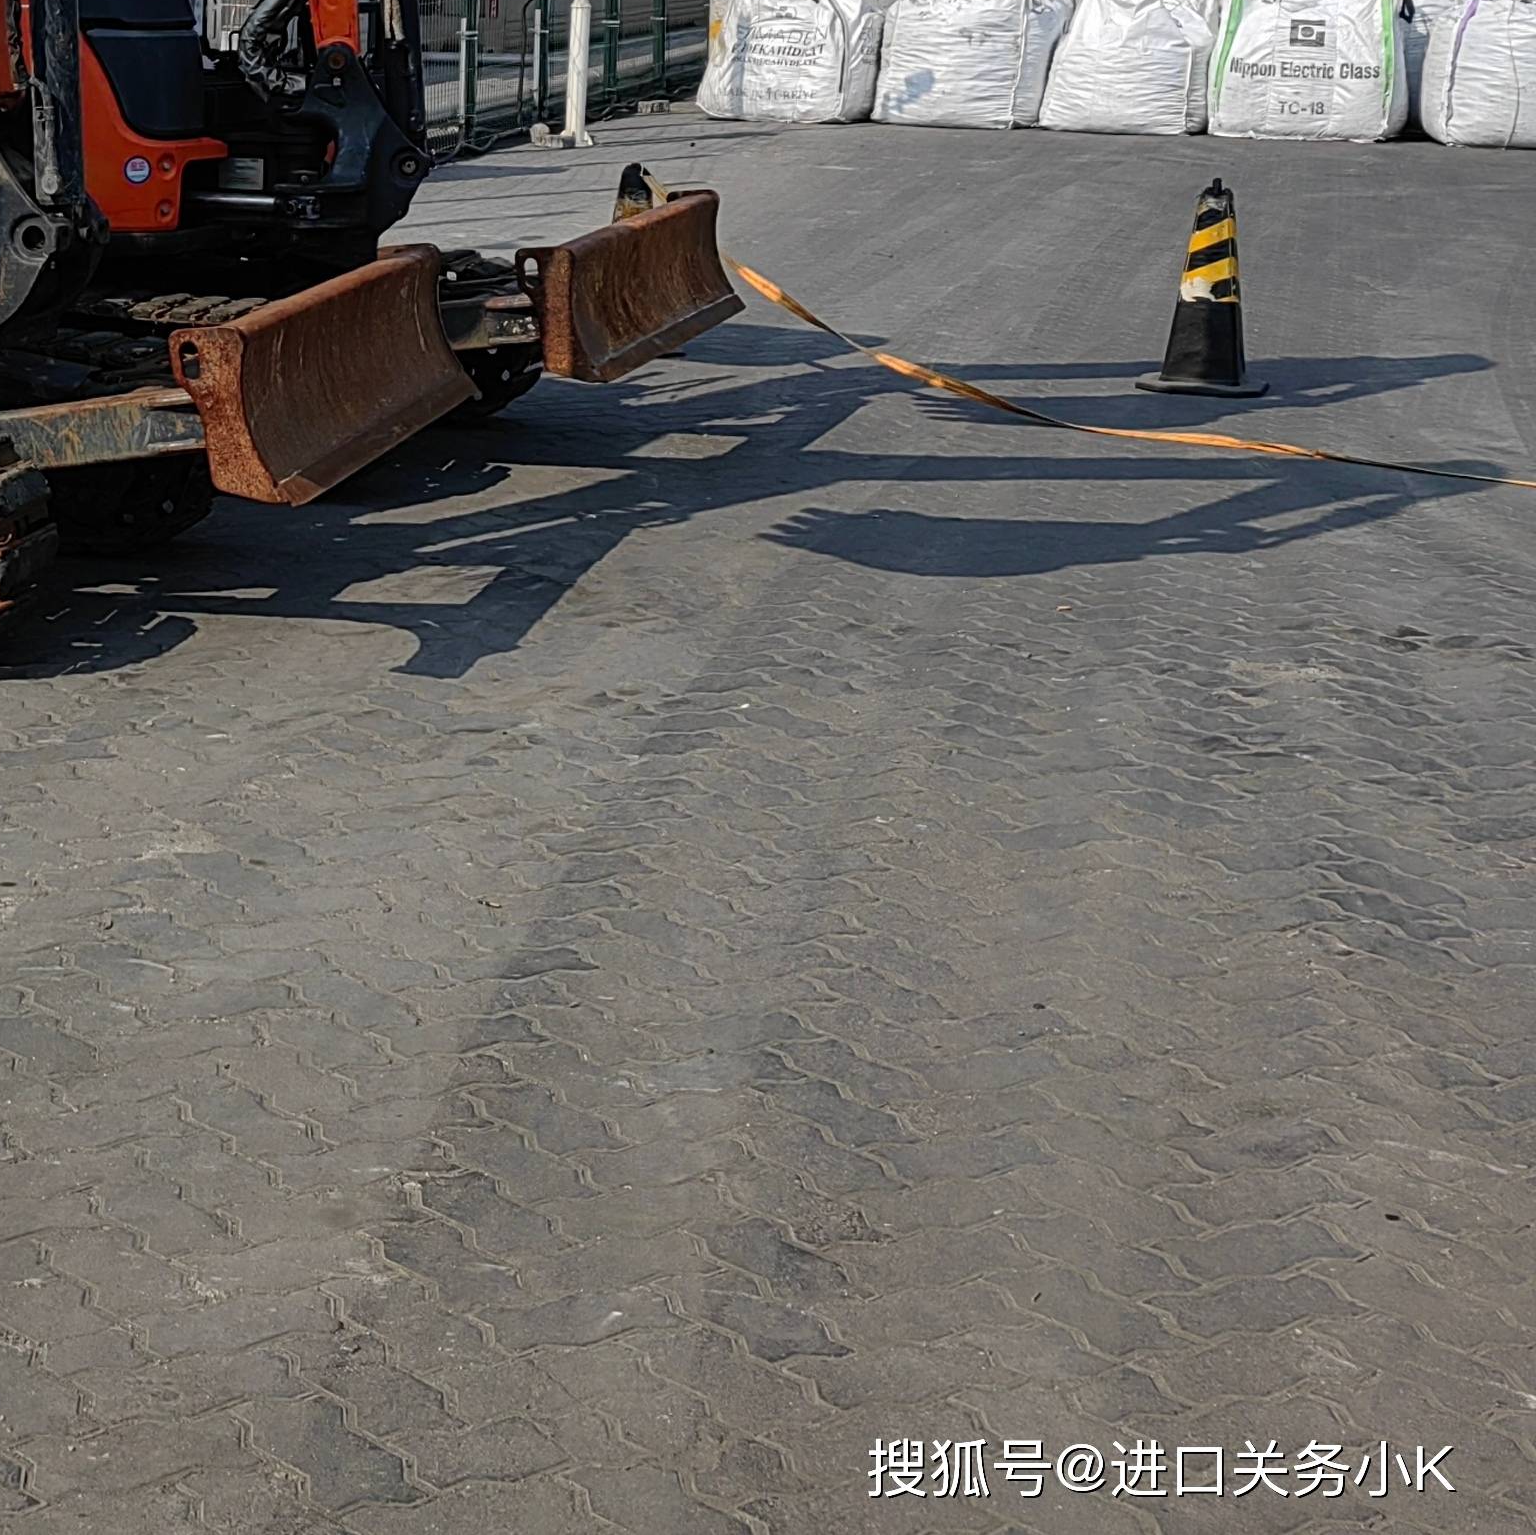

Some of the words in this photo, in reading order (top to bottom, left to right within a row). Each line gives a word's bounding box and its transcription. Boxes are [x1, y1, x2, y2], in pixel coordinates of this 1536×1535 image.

[1230, 57, 1276, 78] Nippon
[1280, 61, 1334, 79] Electric
[1339, 63, 1381, 79] Glass
